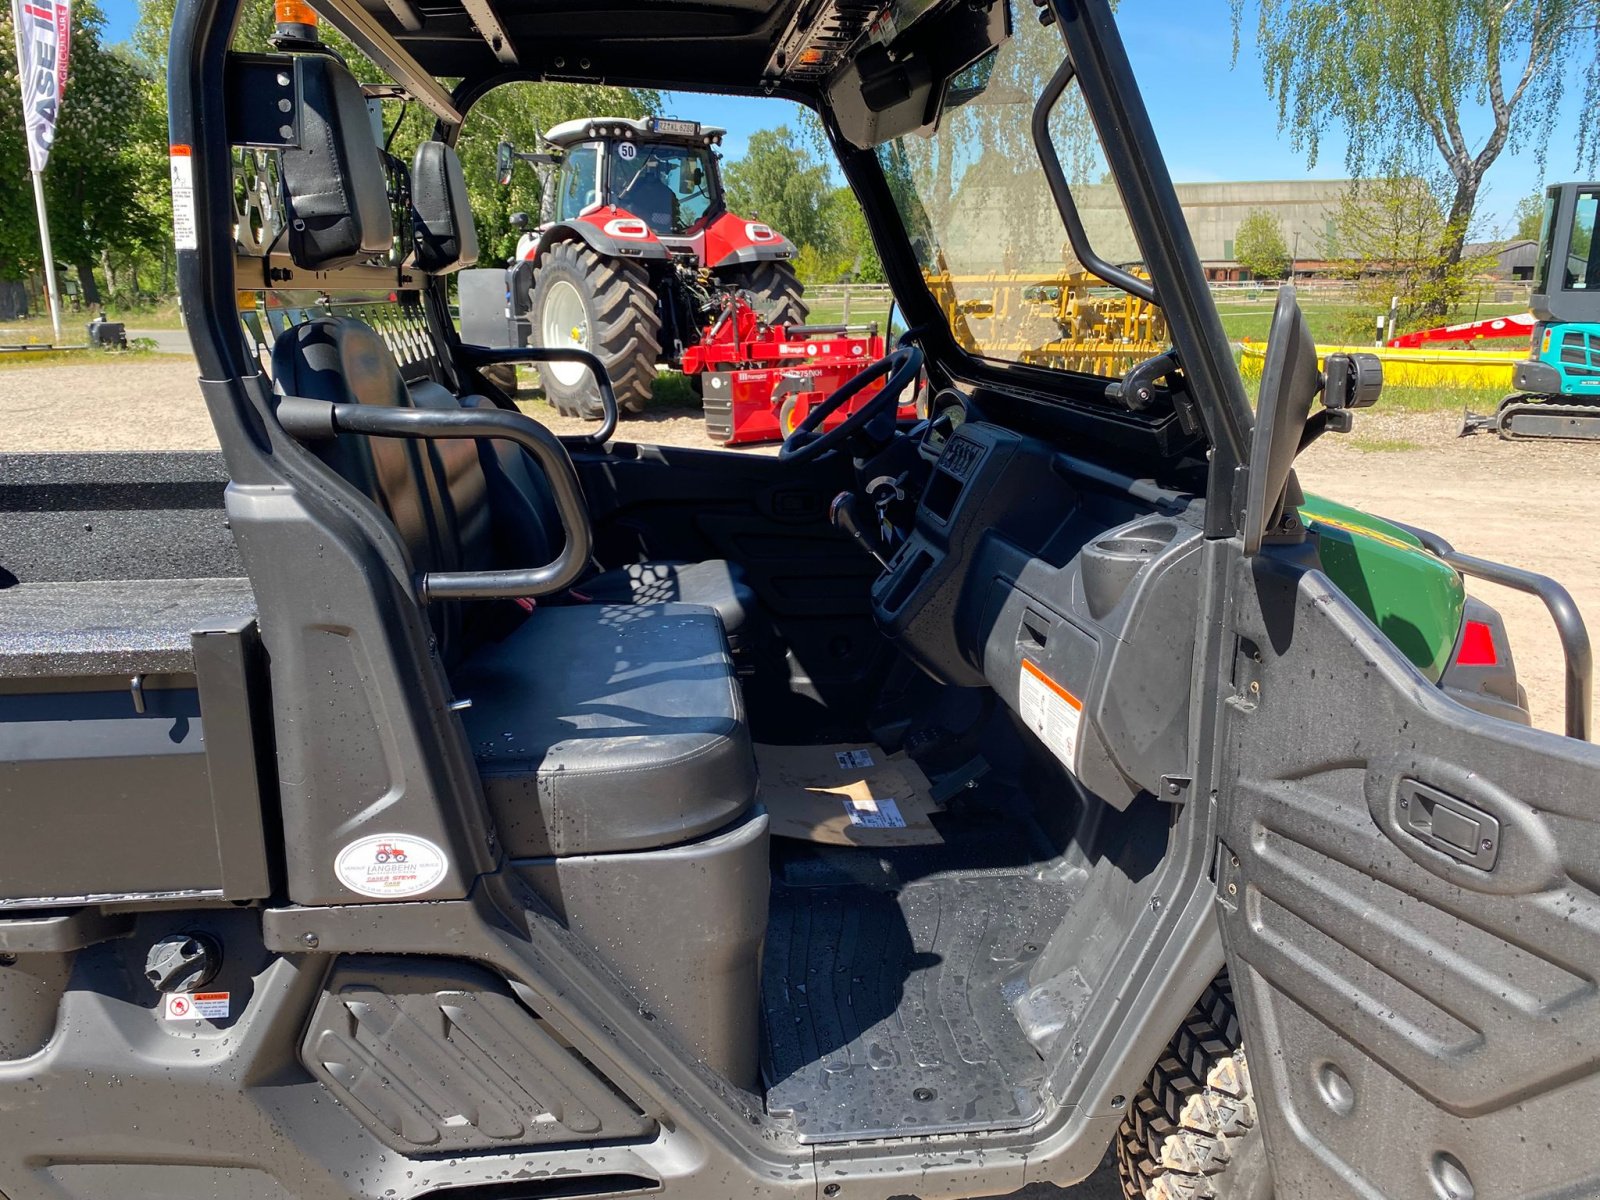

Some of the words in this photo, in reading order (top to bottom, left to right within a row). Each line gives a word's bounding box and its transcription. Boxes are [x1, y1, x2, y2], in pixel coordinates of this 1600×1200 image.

[57, 9, 68, 88] AGRICULTURE
[35, 40, 56, 150] CASE
[621, 145, 634, 157] 50
[367, 864, 417, 875] LANGBEHN
